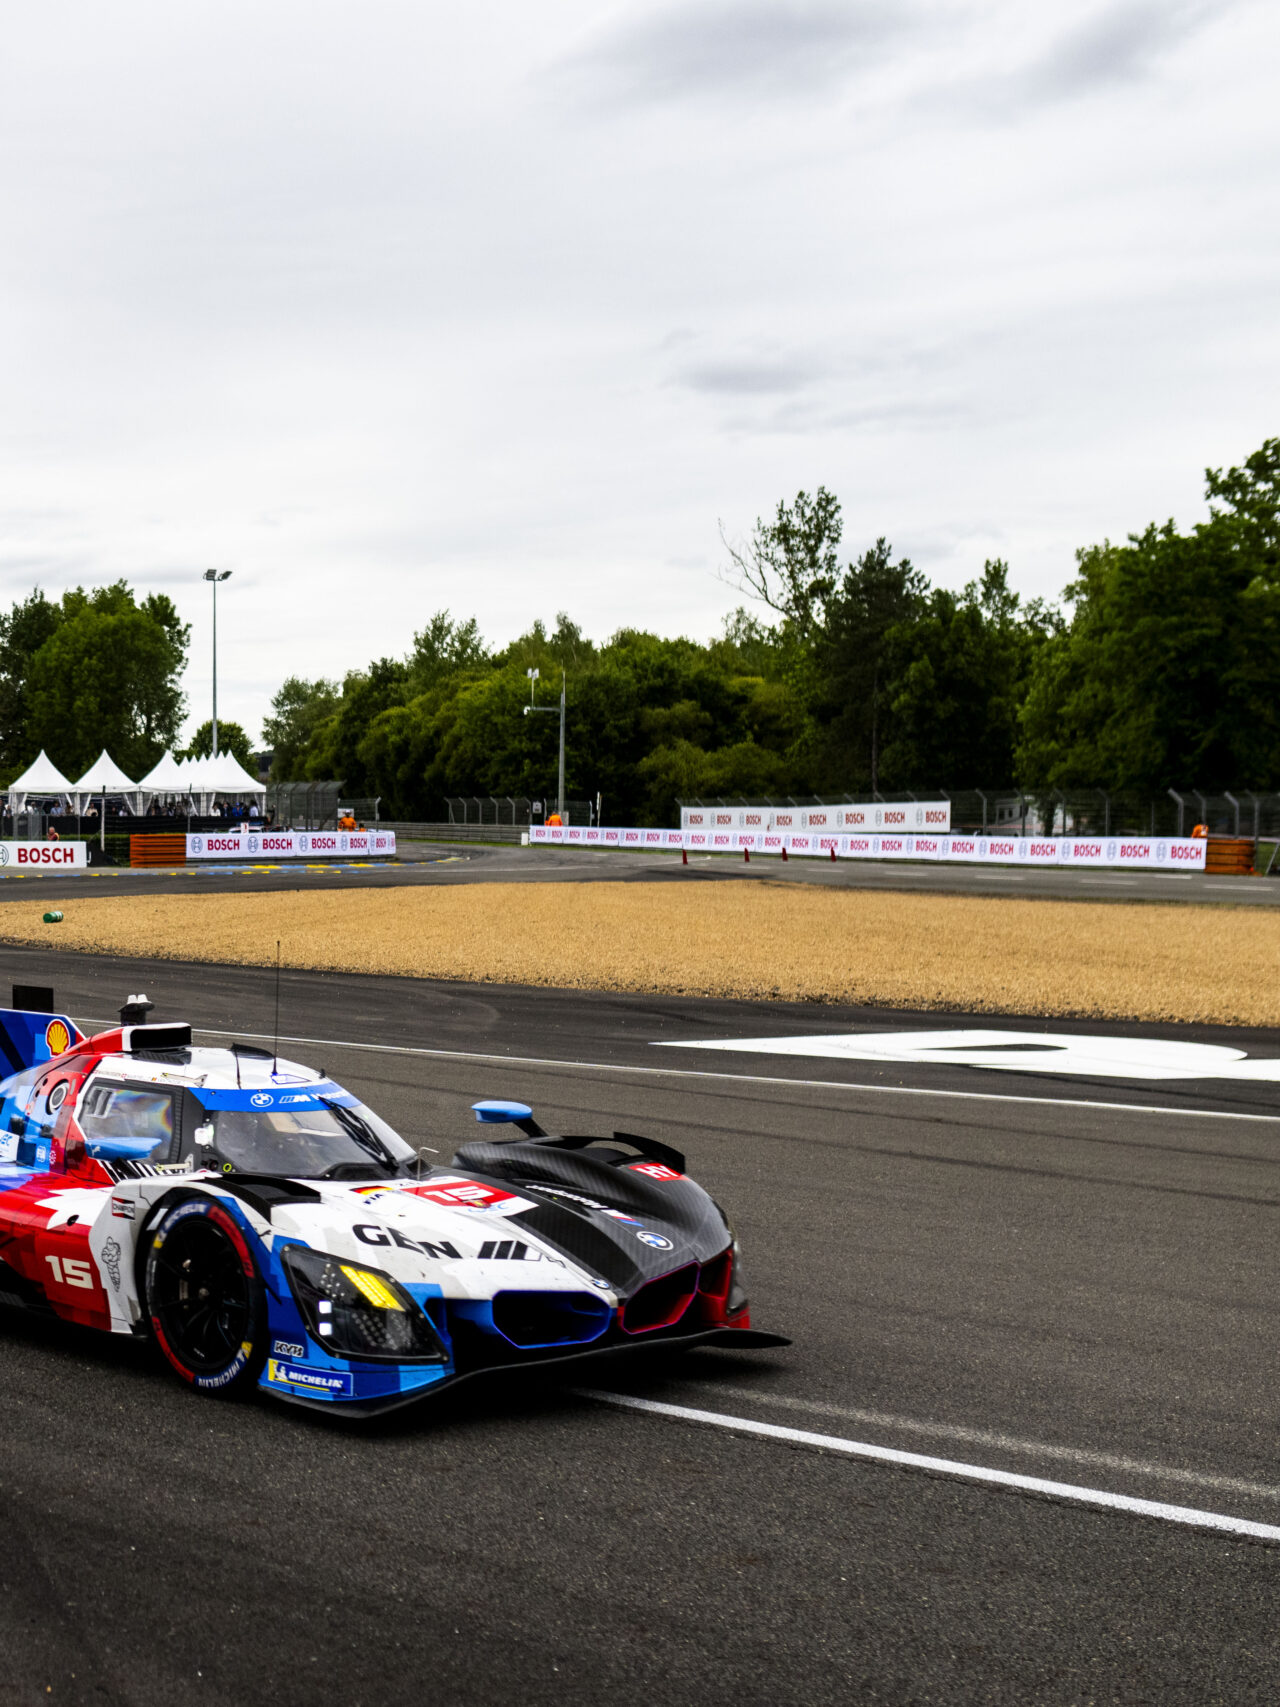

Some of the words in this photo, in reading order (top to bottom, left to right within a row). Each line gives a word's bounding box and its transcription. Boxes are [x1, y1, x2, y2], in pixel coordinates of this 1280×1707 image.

[207, 839, 240, 851] BOSCH
[262, 838, 292, 850] BOSCH
[311, 837, 336, 849] BOSCH
[350, 838, 367, 848] BOSCH
[739, 836, 754, 845] BOSCH
[765, 837, 781, 847] BOSCH
[792, 838, 808, 848] BOSCH
[820, 839, 838, 849] BOSCH
[850, 840, 869, 850] BOSCH
[881, 840, 902, 851] BOSCH
[916, 840, 937, 852] BOSCH
[952, 842, 974, 853] BOSCH
[990, 843, 1014, 855] BOSCH
[1030, 844, 1056, 856] BOSCH
[1074, 844, 1101, 857] BOSCH
[1120, 844, 1150, 858] BOSCH
[1171, 845, 1202, 860] BOSCH
[17, 847, 74, 864] BOSCH
[637, 1165, 678, 1179] HY
[424, 1185, 495, 1202] 15
[45, 1255, 94, 1289] 15
[198, 1360, 240, 1388] MICHELIN
[288, 1371, 343, 1388] MICHELIN
